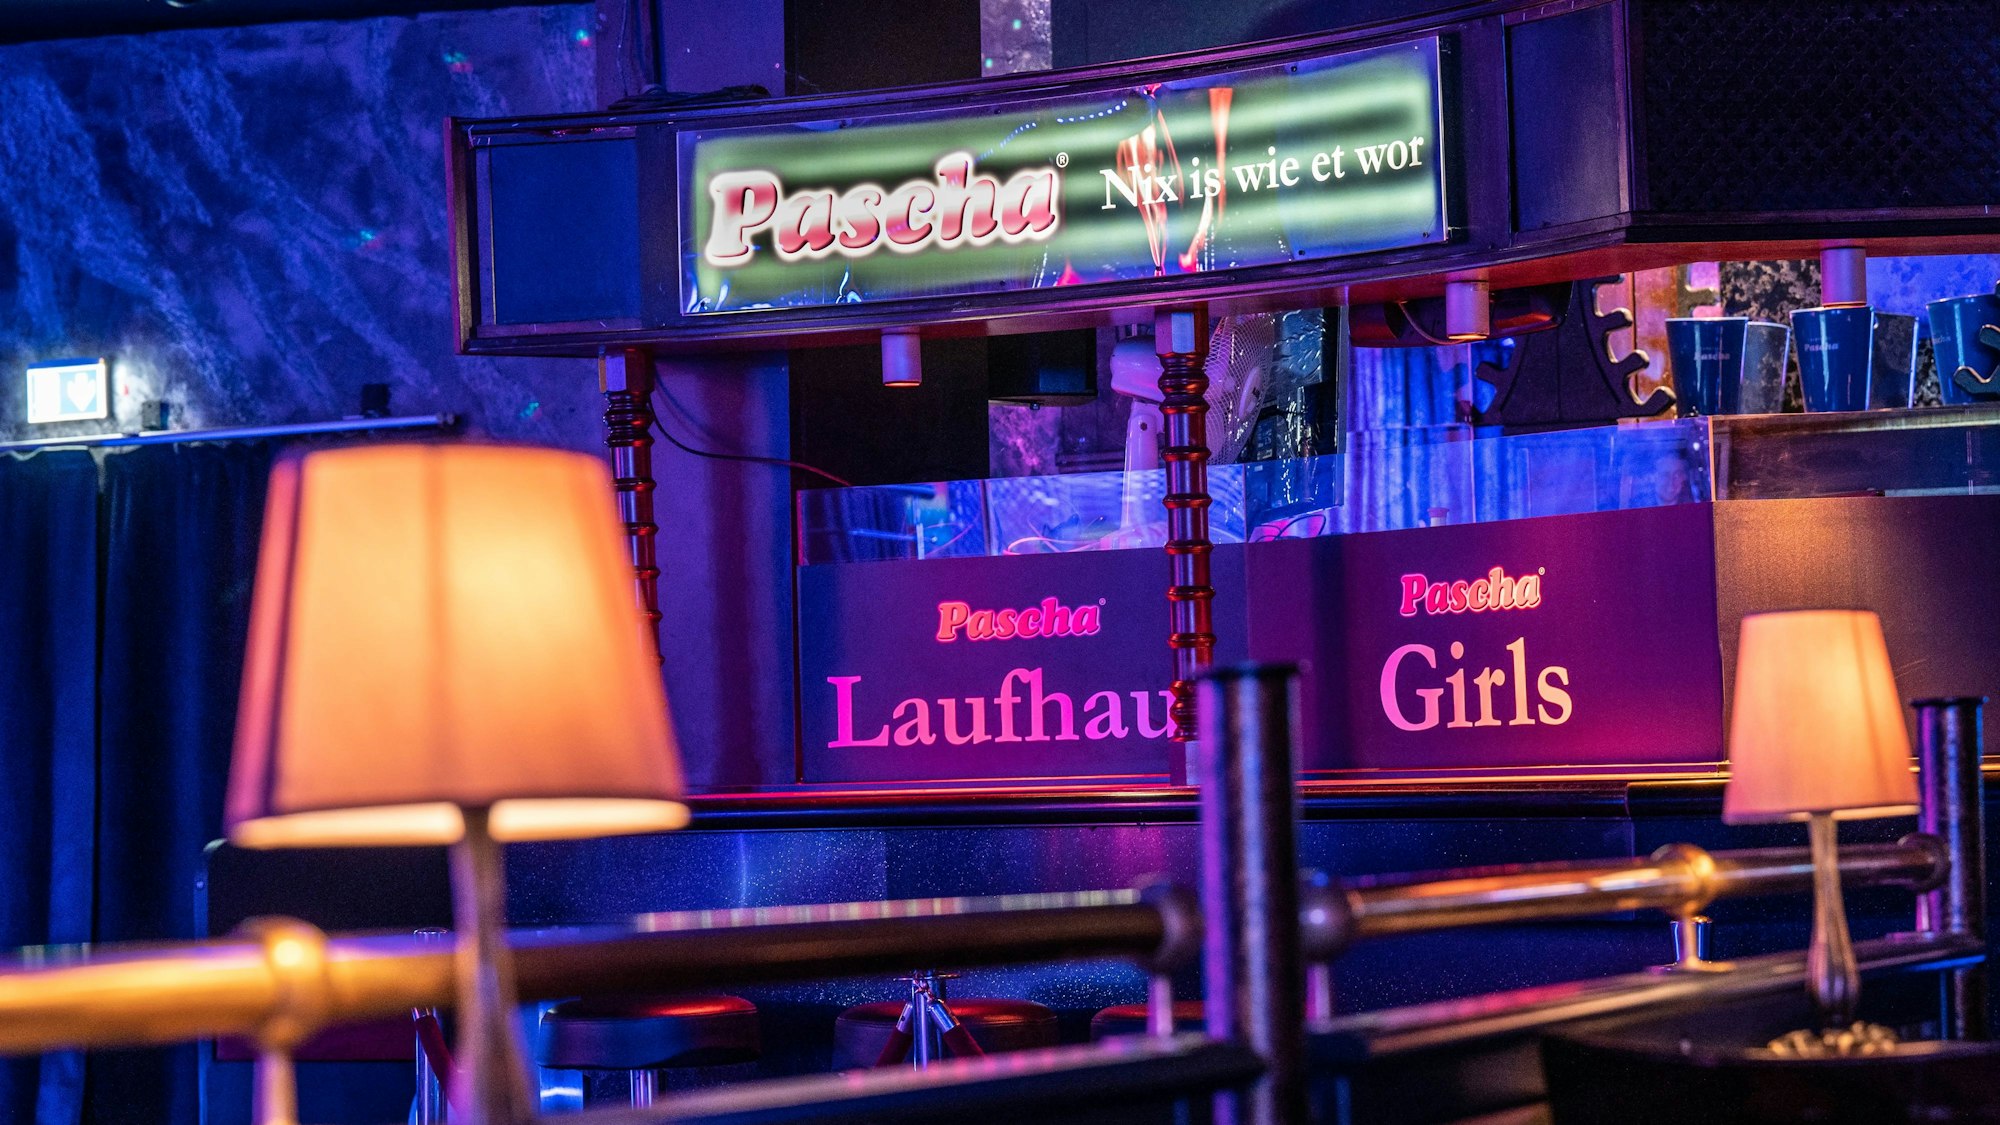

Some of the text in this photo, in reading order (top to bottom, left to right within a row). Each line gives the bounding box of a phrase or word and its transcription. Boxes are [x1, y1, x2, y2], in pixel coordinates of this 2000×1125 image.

[1099, 136, 1424, 210] Nix is wie et wor
[1380, 637, 1573, 731] Girls
